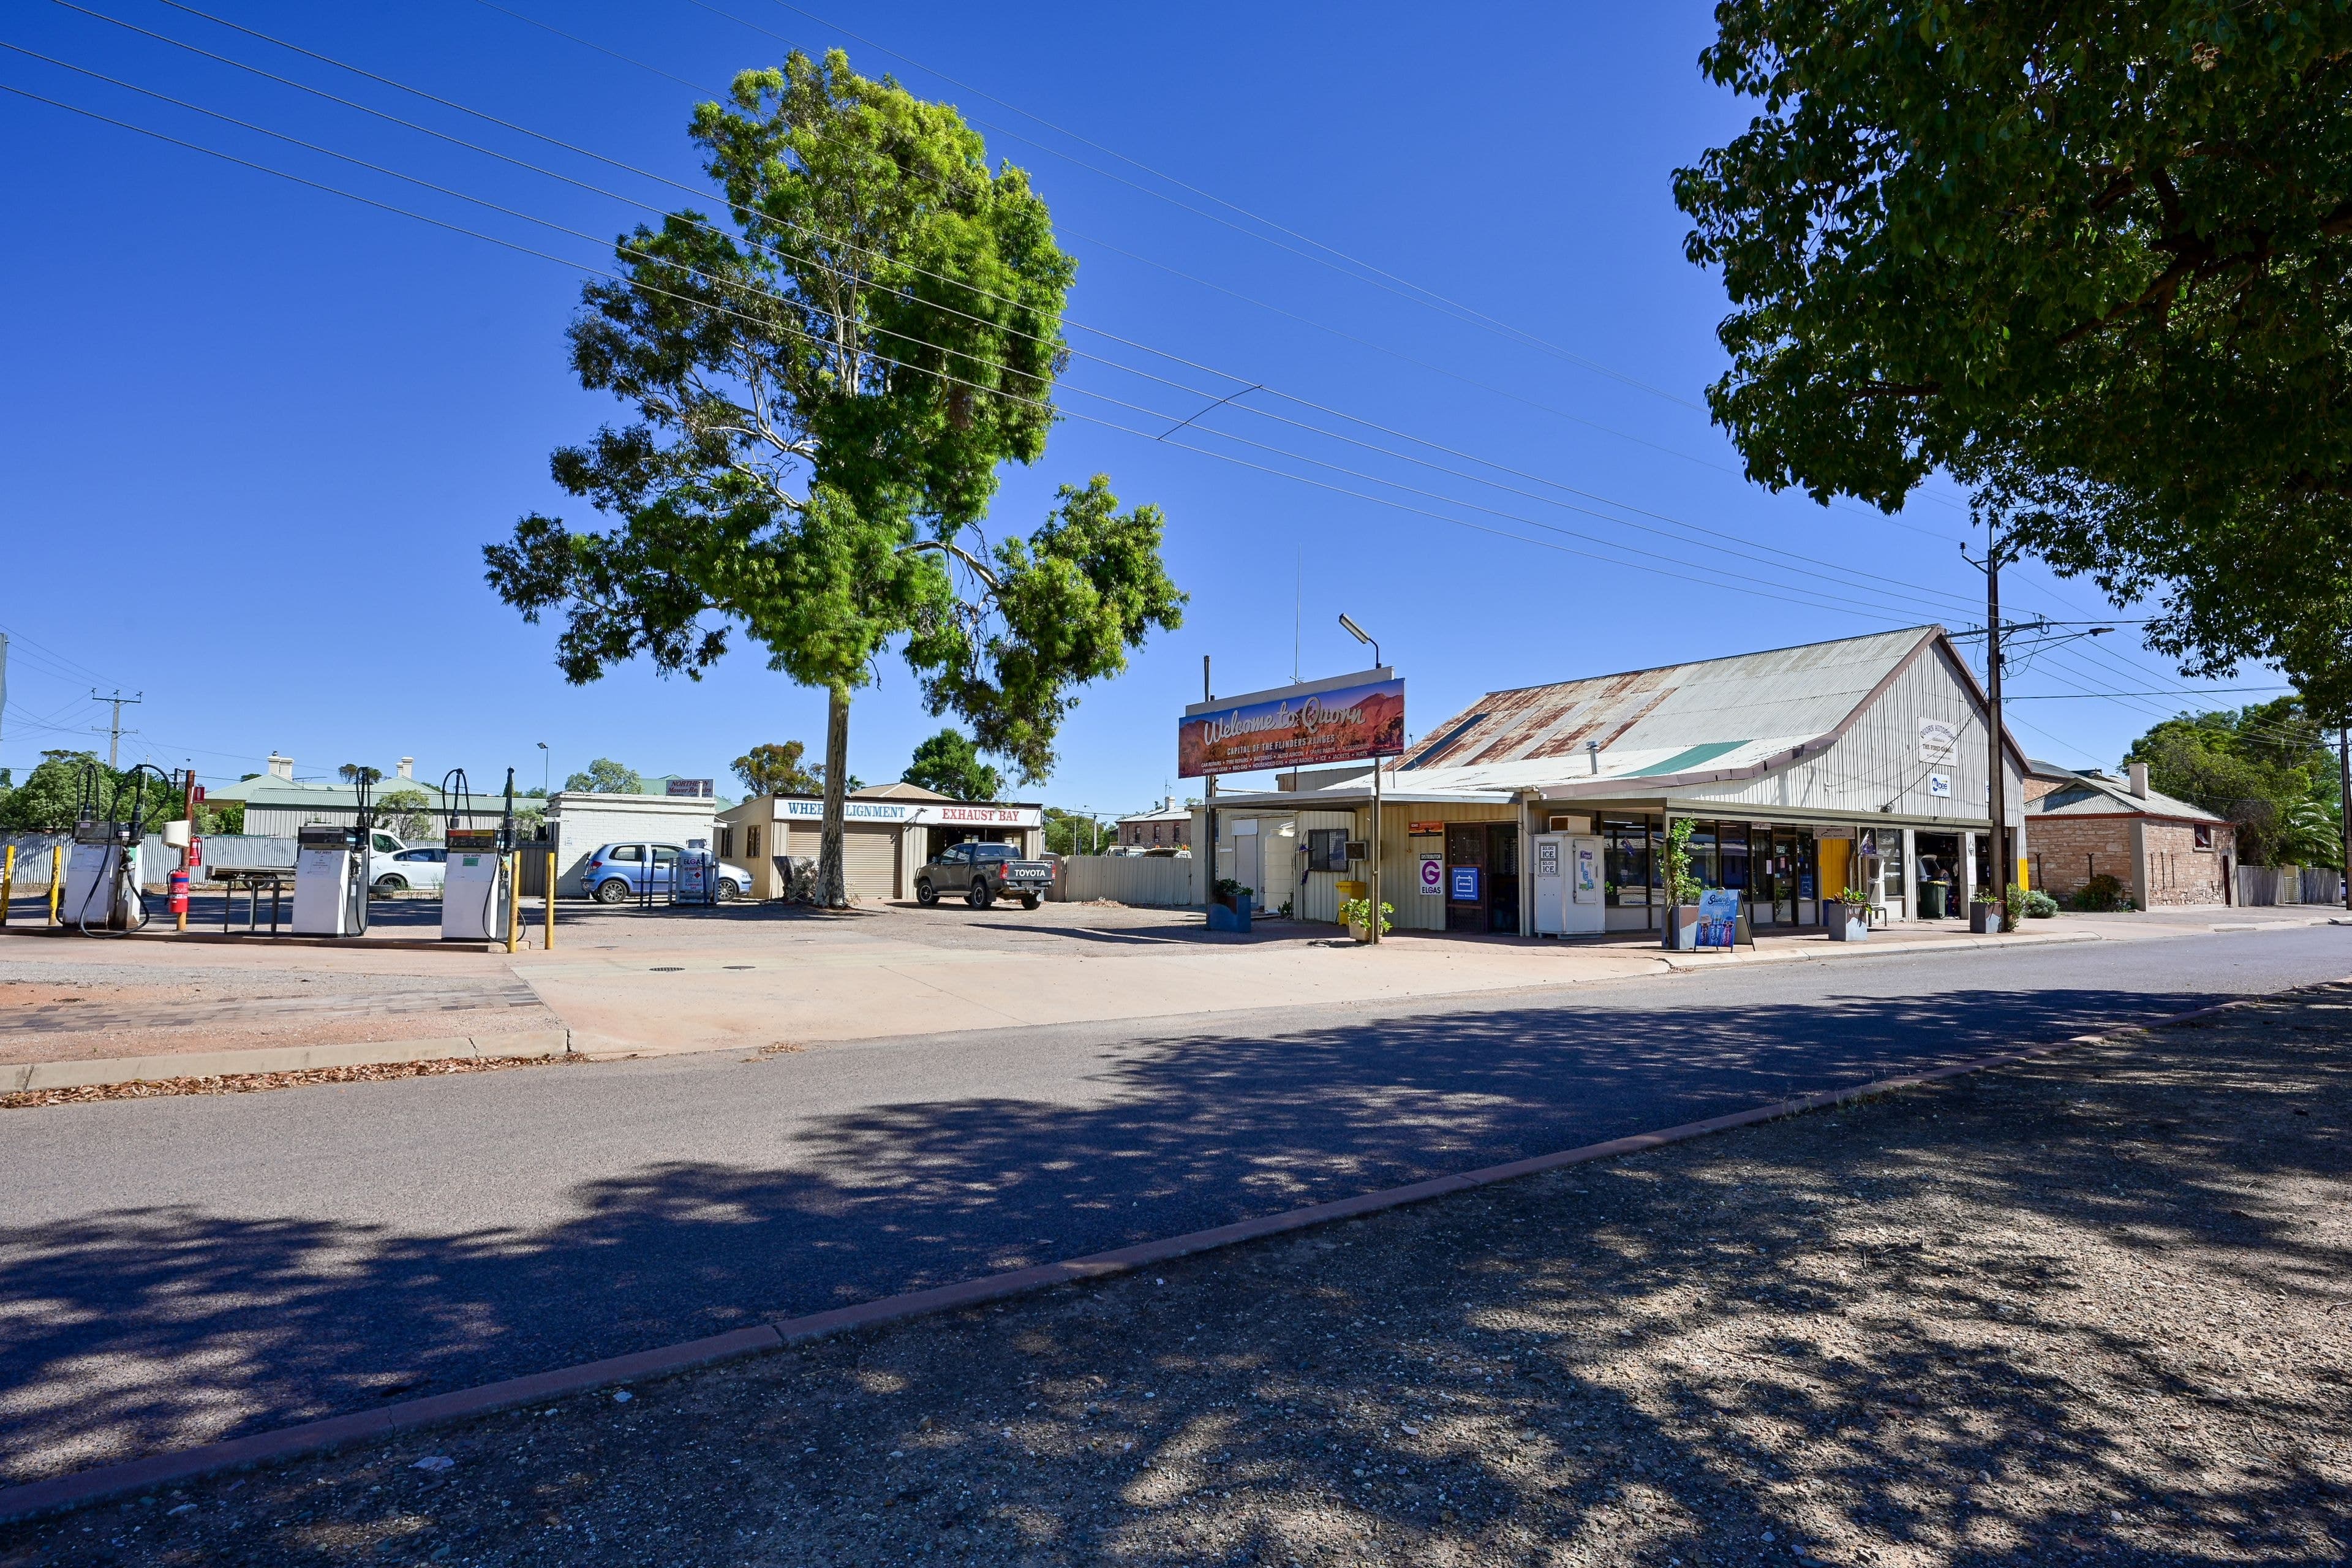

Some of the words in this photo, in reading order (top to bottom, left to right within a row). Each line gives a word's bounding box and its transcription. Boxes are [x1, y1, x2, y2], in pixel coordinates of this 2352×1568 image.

[1204, 710, 1275, 745] Welcome
[1276, 701, 1295, 729] to
[1302, 696, 1366, 734] Quorn
[1227, 746, 1250, 756] CAPITAL
[1262, 742, 1273, 752] THE
[1275, 737, 1306, 750] FLINDERS
[1308, 734, 1335, 745] RANGES
[788, 802, 824, 815] WHEE
[845, 805, 905, 818] LIGNMENT
[942, 809, 995, 821] EXHAUST
[998, 810, 1020, 821] BAY
